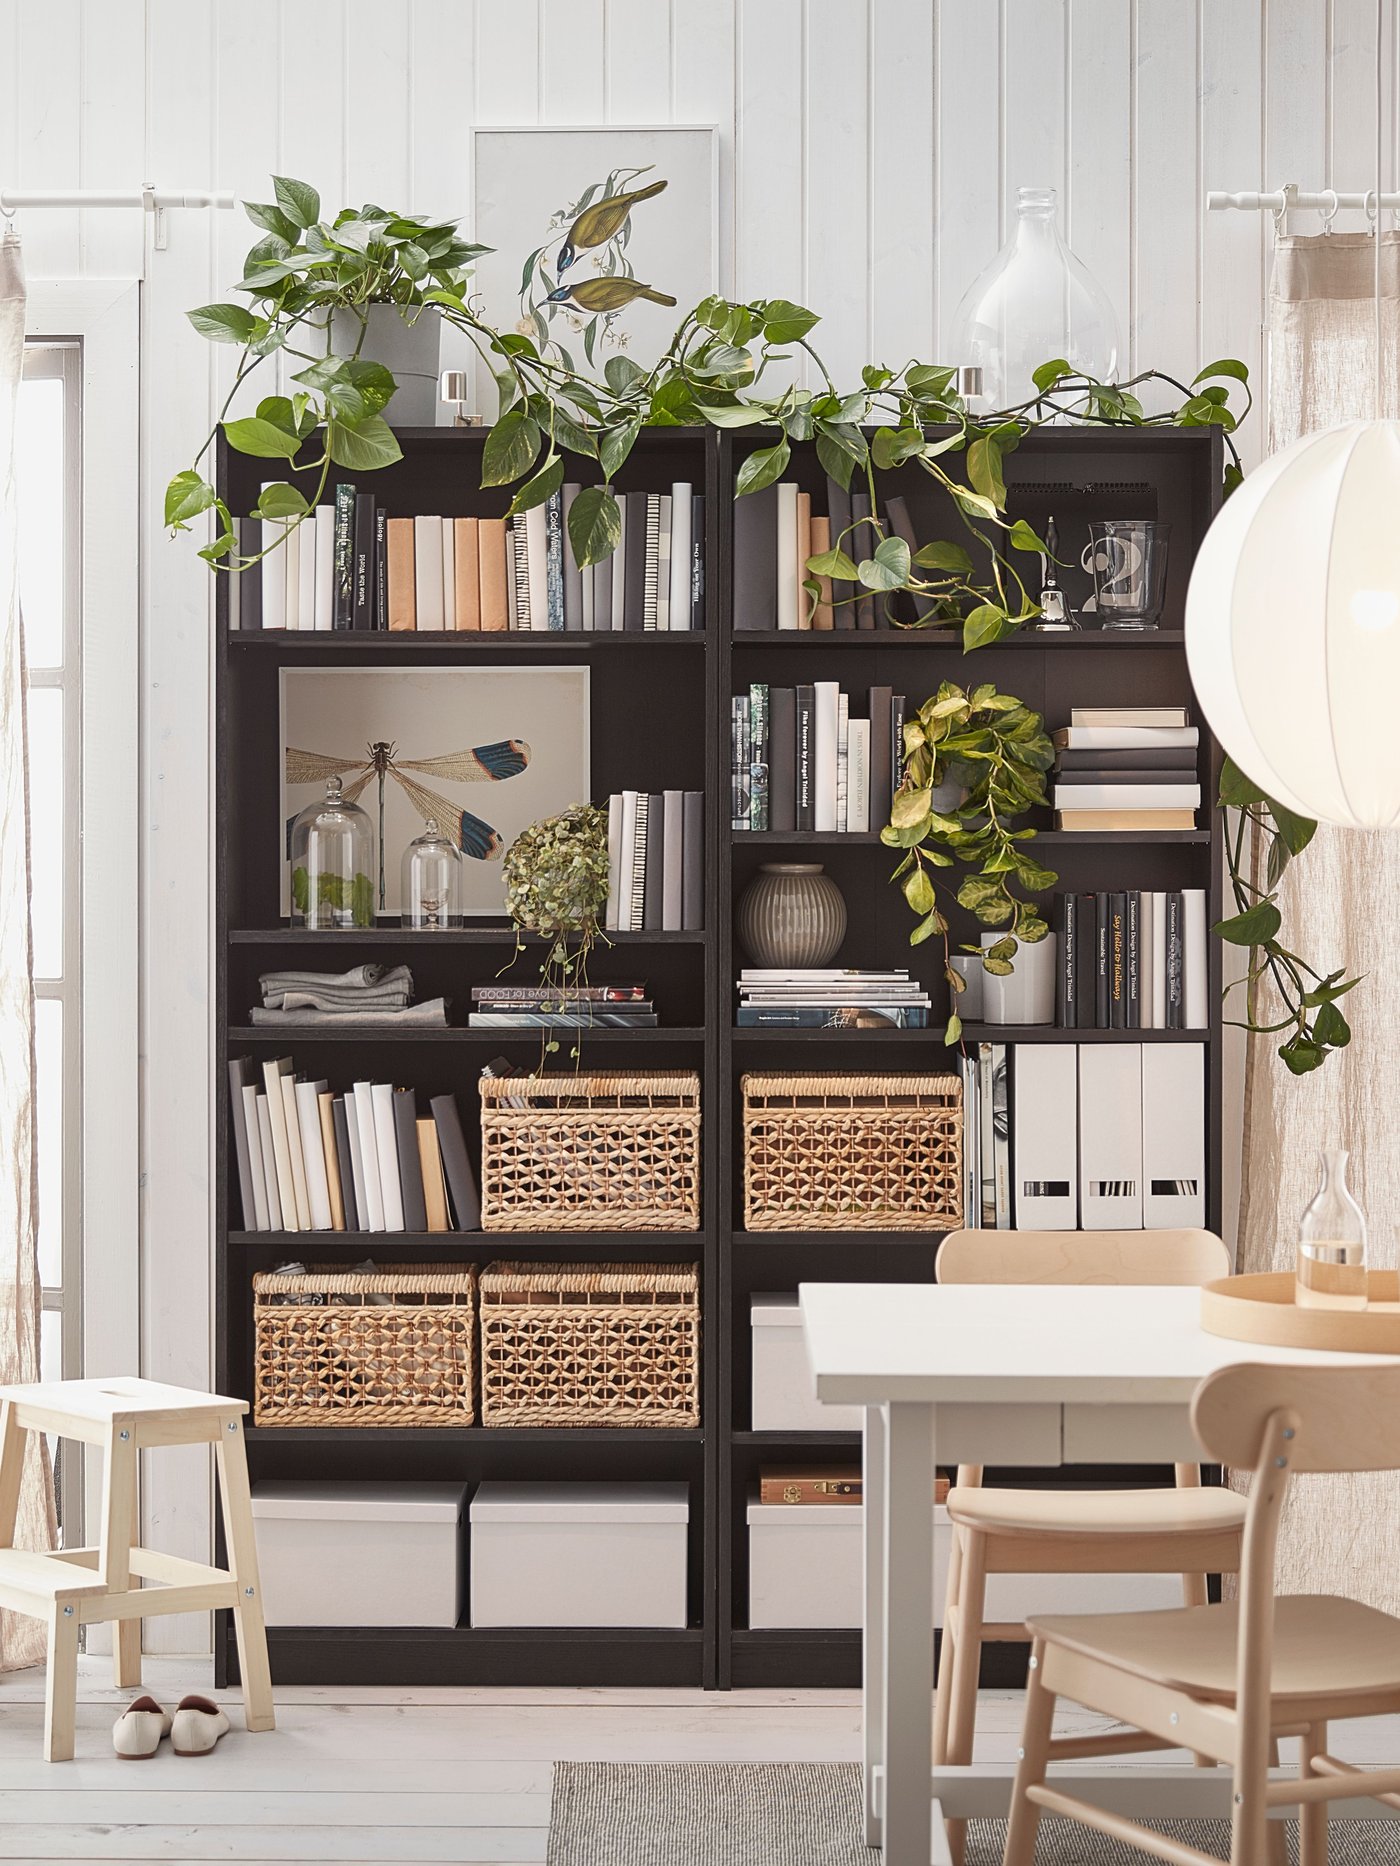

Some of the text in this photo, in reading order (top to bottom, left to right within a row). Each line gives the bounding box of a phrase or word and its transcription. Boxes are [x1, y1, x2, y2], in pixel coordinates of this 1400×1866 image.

[550, 491, 558, 510] rom
[377, 516, 385, 542] Biology
[550, 511, 559, 530] Cold
[550, 531, 559, 560] Waters
[358, 554, 366, 606] Taste the World
[801, 751, 809, 759] by
[801, 760, 809, 779] Angel
[1113, 914, 1122, 1001] Say Hello to Hallways
[480, 990, 550, 999] love for FOOD
